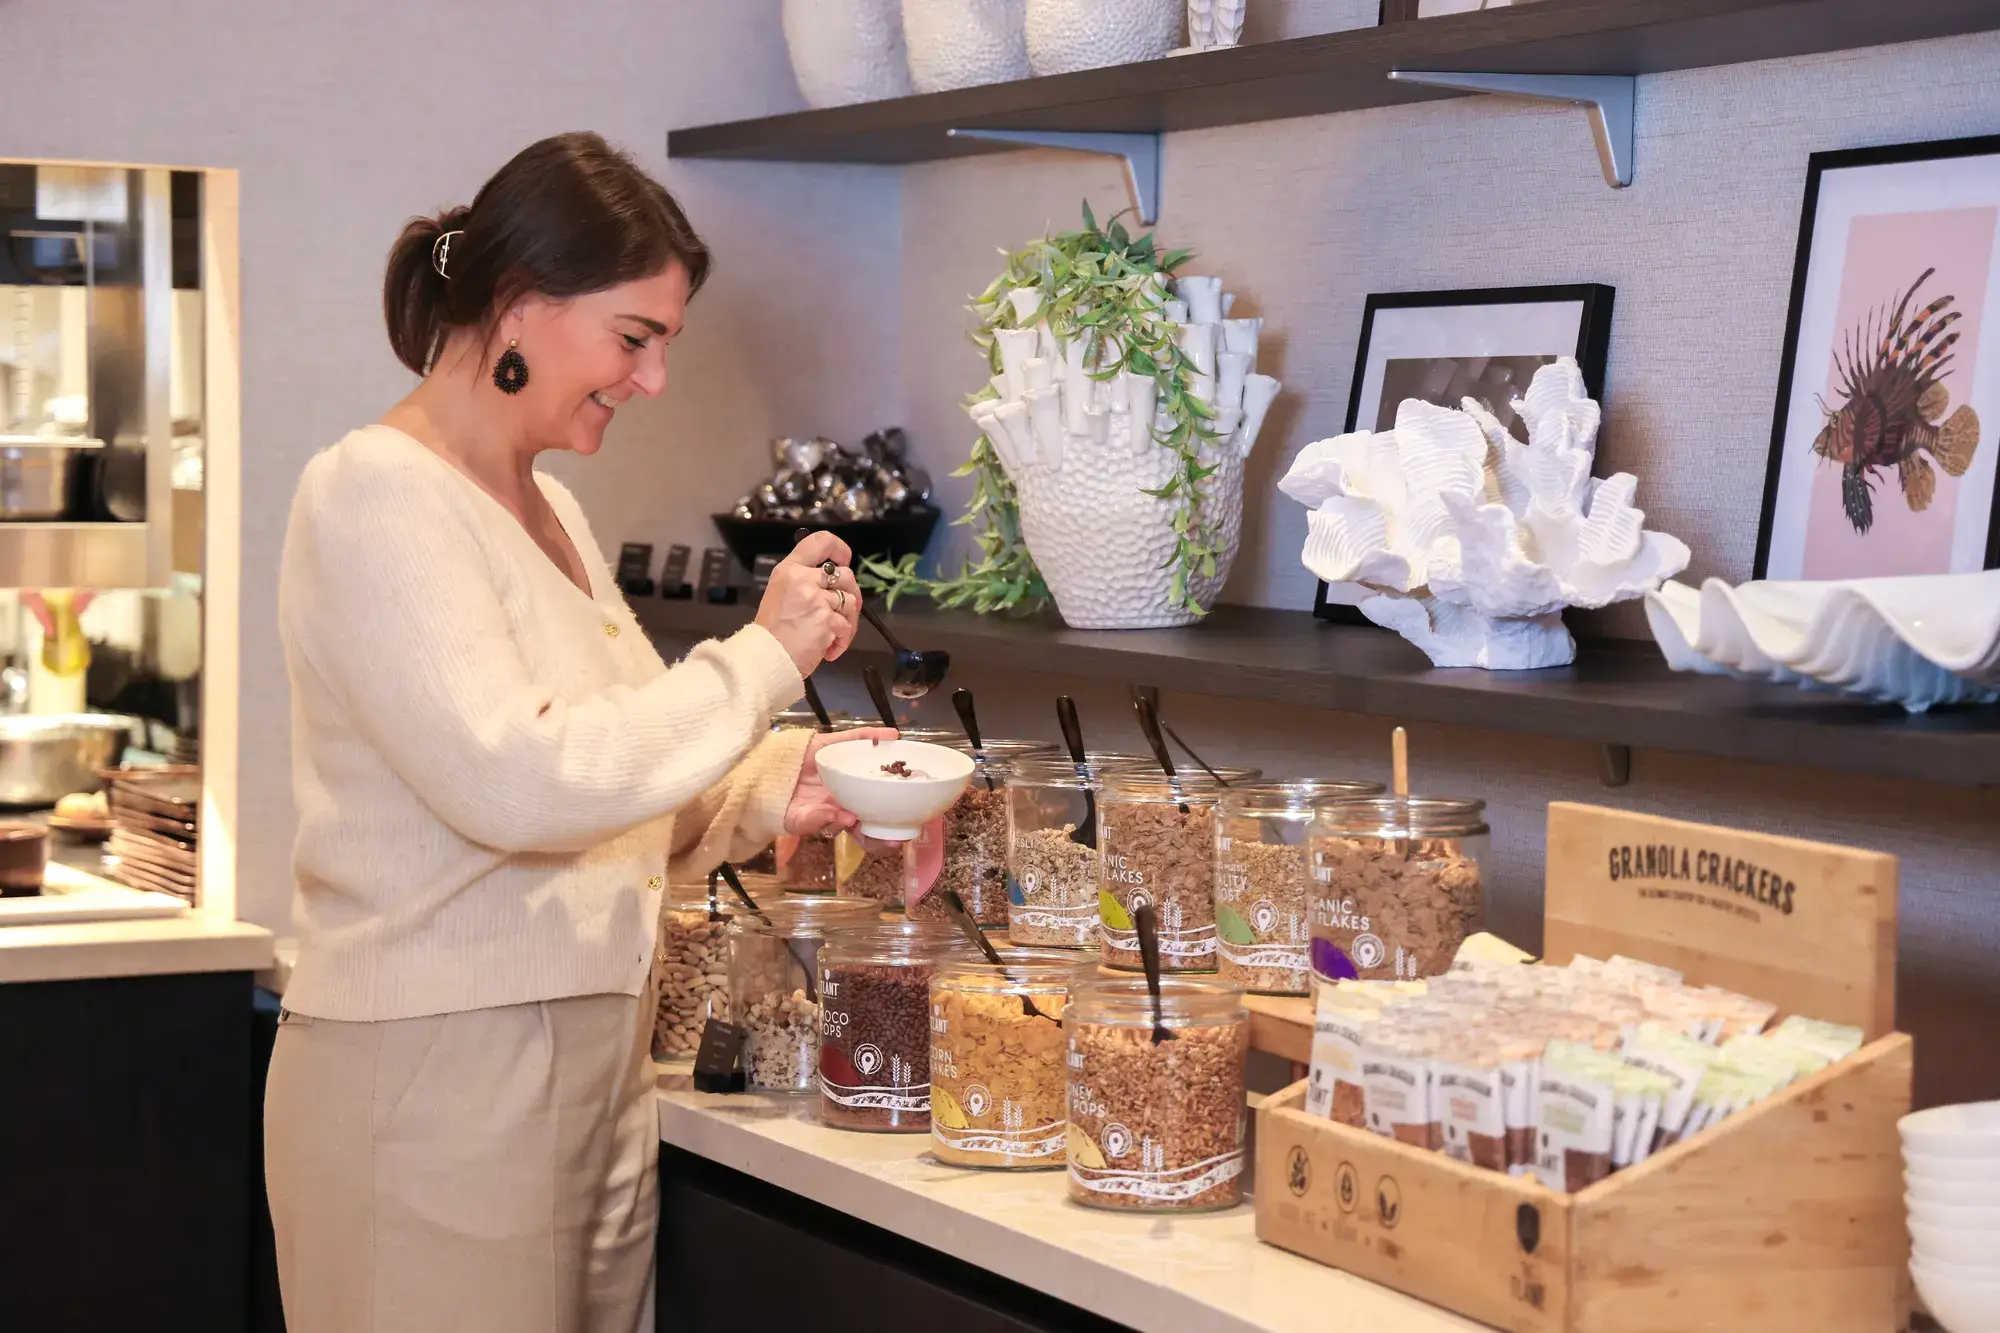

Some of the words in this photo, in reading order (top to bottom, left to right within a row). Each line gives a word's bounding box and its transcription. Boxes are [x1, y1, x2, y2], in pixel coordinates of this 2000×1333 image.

[1016, 837, 1035, 849] ESLI
[1103, 854, 1127, 870] ANIC
[1609, 845, 1690, 881] GRANOLA
[1696, 849, 1796, 915] CRACKERS
[1220, 887, 1241, 902] OST
[823, 1010, 849, 1026] OCO
[823, 1025, 842, 1038] OPS
[932, 1062, 958, 1079] AKES
[1071, 1084, 1094, 1101] NEY
